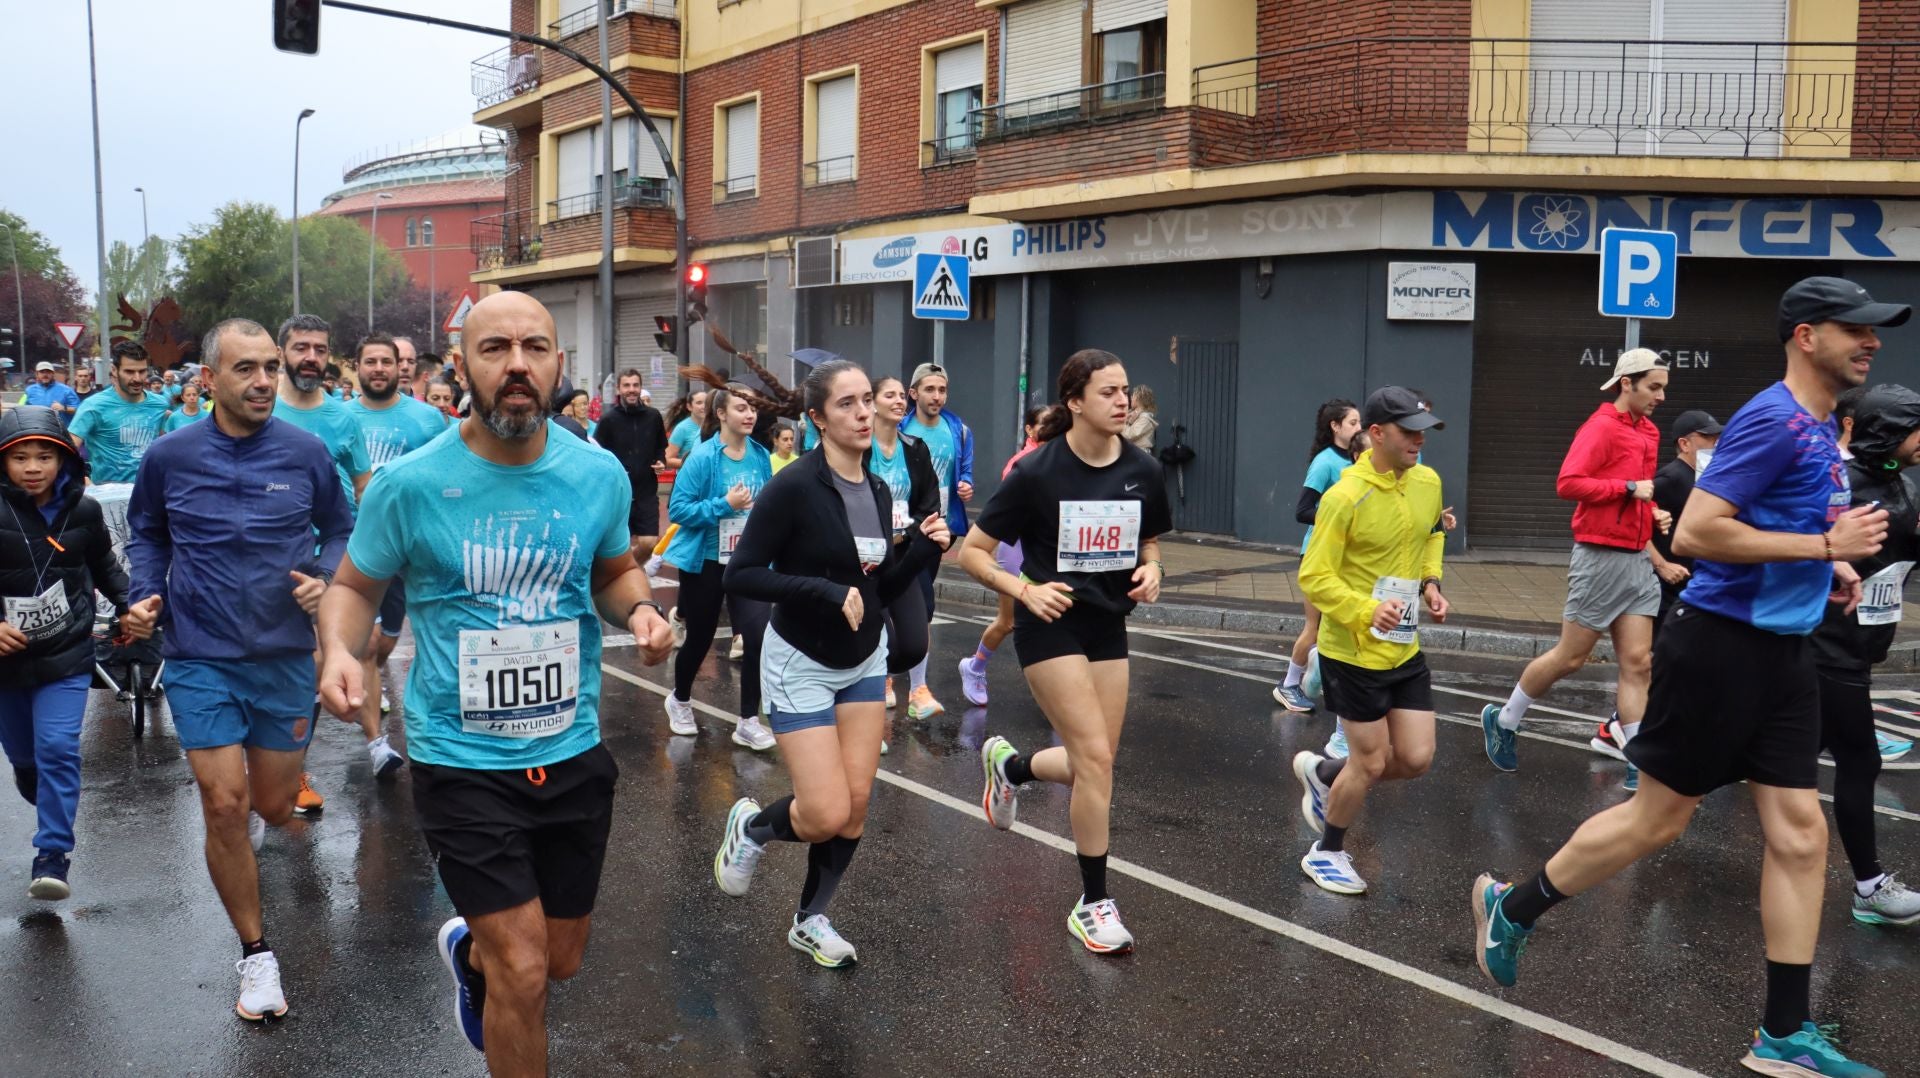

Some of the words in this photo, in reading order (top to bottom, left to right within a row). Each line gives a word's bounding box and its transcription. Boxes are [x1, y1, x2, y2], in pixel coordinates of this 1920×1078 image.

[1134, 212, 1209, 247] JVC
[1242, 201, 1363, 234] SONY
[1432, 191, 1897, 257] MONFER
[962, 236, 988, 262] LG
[1013, 217, 1106, 256] PHILIPS
[843, 269, 907, 282] SERVICIO
[1126, 246, 1219, 262] TECNICA
[878, 246, 914, 259] SAMSUN
[1617, 240, 1661, 306] P
[1393, 286, 1472, 298] MONFER
[1580, 348, 1709, 369] ALCEN
[1078, 526, 1121, 551] 1148
[1088, 559, 1124, 567] HYUNDAI
[17, 599, 63, 631] 2335
[503, 655, 532, 667] DAVID
[537, 654, 548, 663] SA
[485, 662, 563, 709] 1050
[512, 715, 564, 731] HYUNDAI
